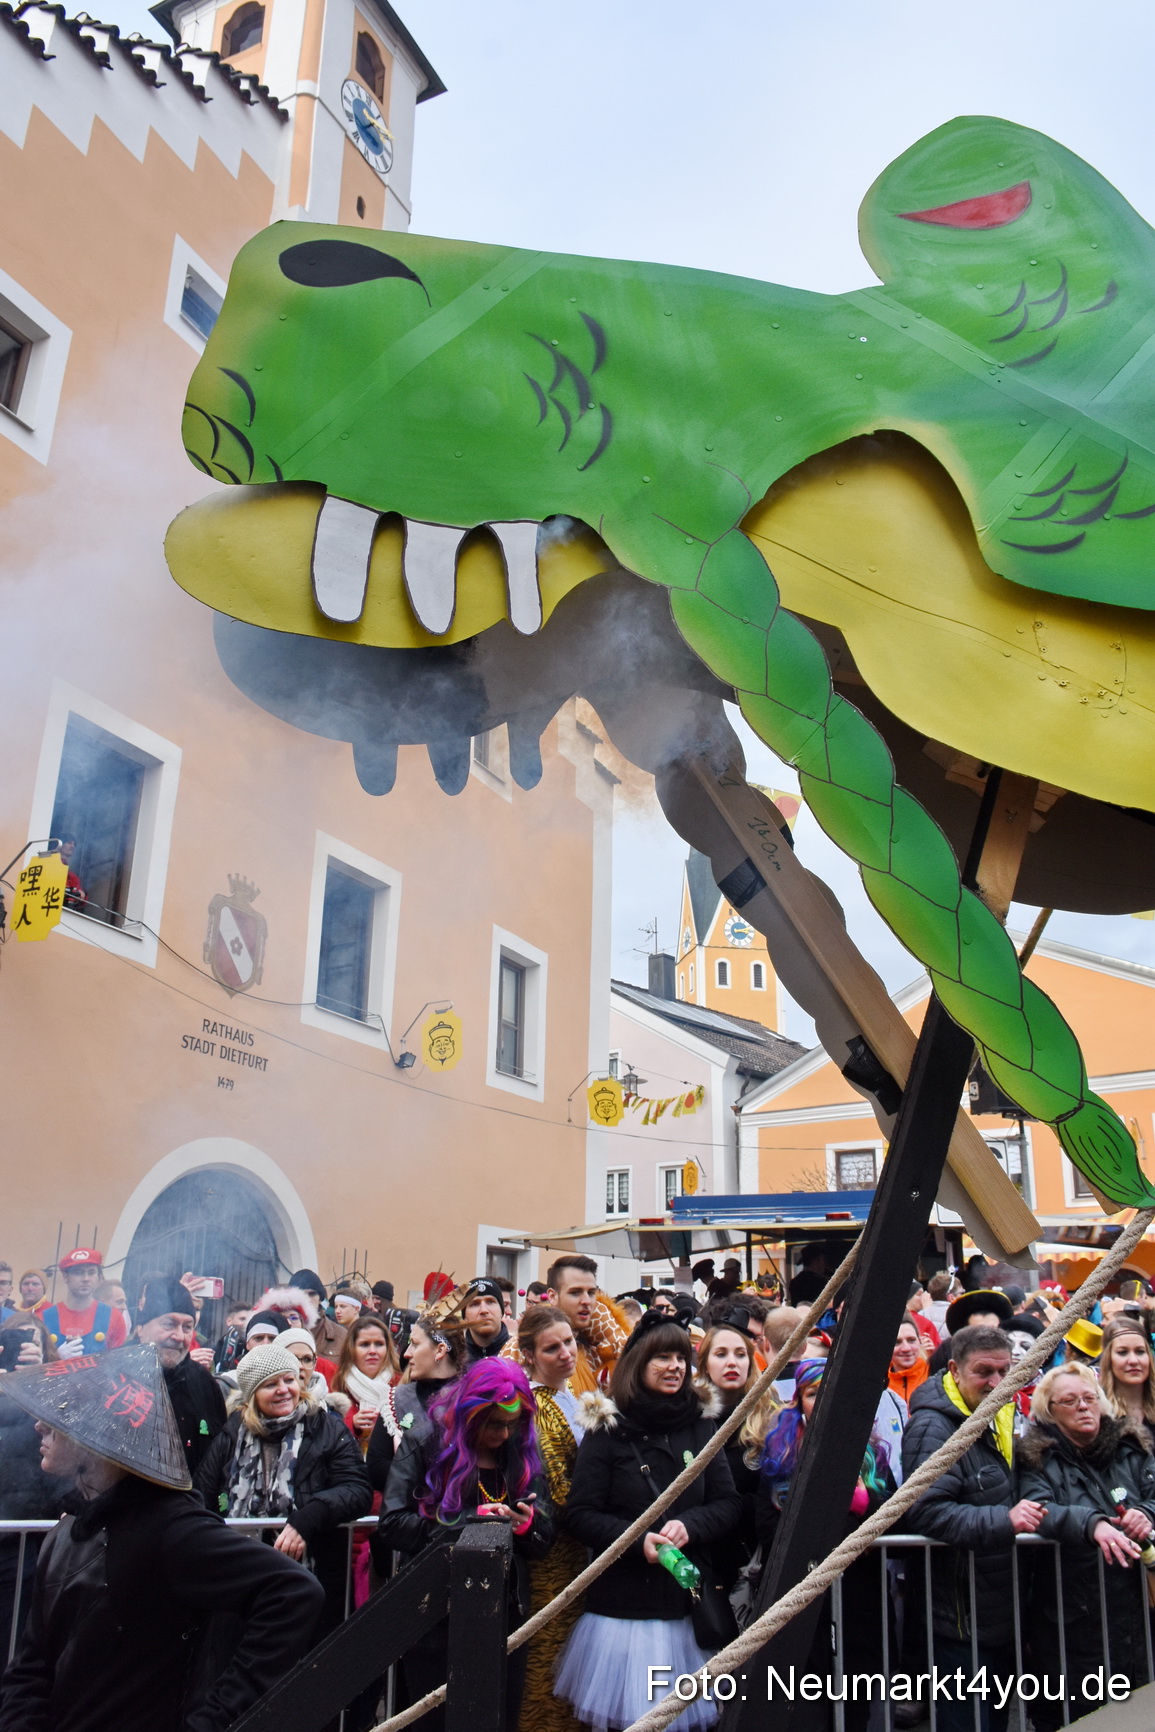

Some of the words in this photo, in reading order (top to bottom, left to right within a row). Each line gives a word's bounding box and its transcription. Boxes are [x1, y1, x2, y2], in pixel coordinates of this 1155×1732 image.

[201, 1018, 255, 1048] RATHAUS
[180, 1034, 217, 1057] STADT
[219, 1044, 269, 1072] DIETFURT
[217, 1076, 234, 1092] 1479
